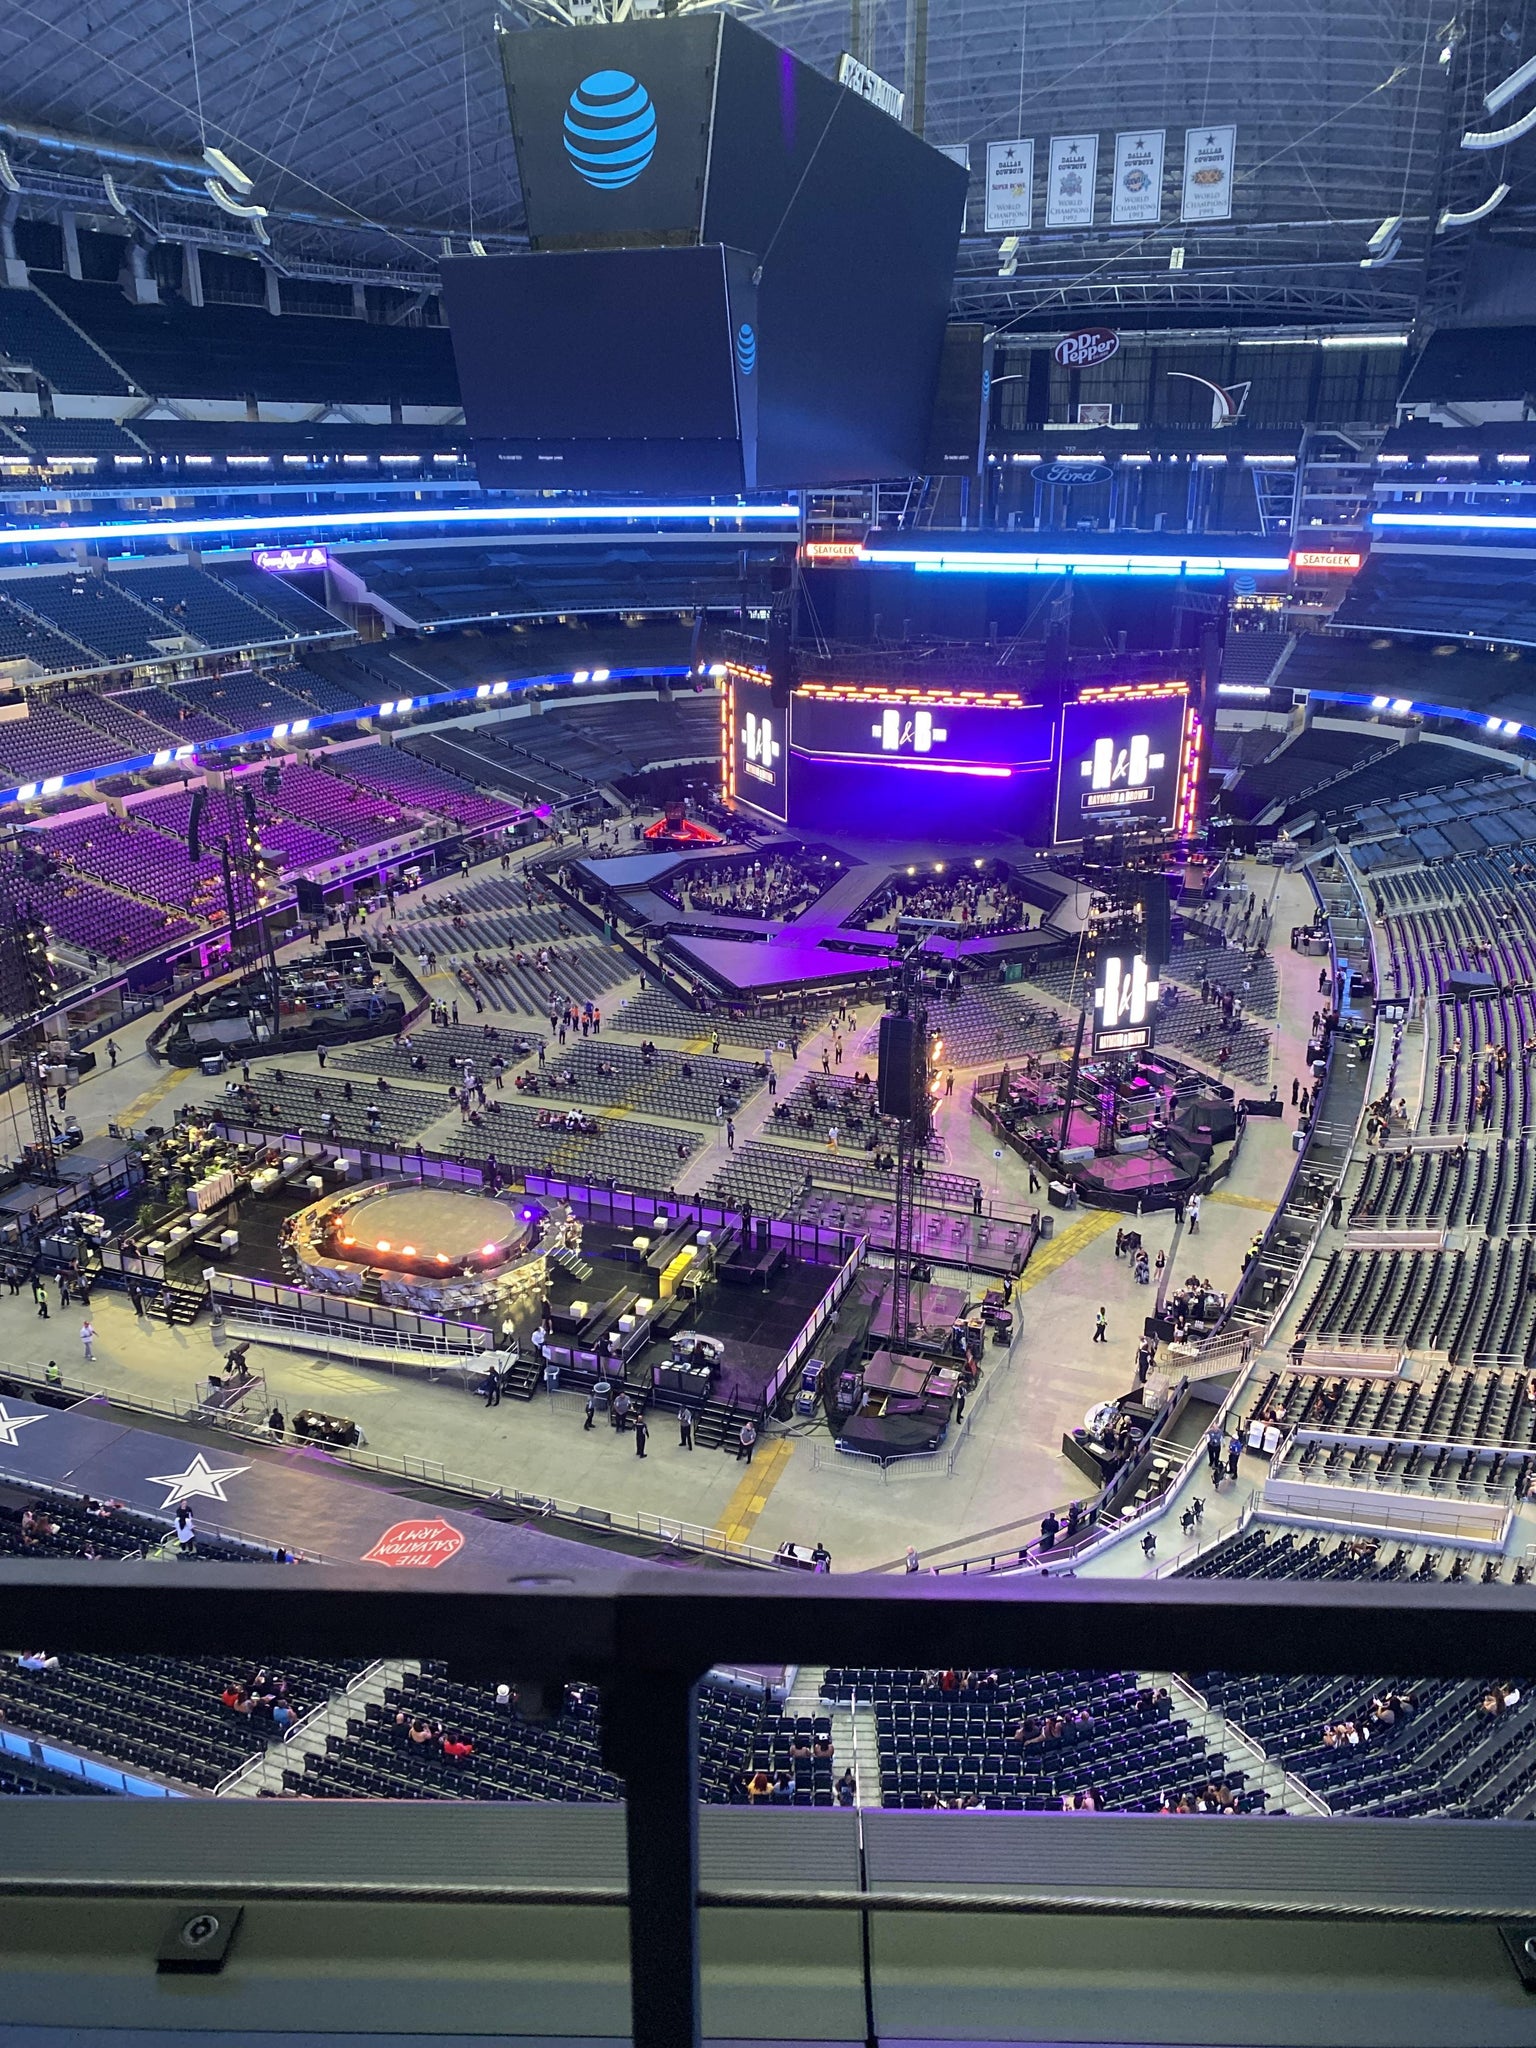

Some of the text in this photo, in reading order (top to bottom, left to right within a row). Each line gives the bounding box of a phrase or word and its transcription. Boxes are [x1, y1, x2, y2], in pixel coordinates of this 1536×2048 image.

[1127, 152, 1151, 160] DALLAS
[1198, 147, 1222, 156] DALLAS
[1061, 156, 1085, 164] DALLAS
[1124, 158, 1154, 167] COWBOYS
[1194, 154, 1225, 163] COWBOYS
[998, 160, 1022, 168] DALLAS
[1058, 163, 1087, 171] COWBOYS
[995, 167, 1024, 176] COWBOYS
[1078, 333, 1100, 350] Dr
[1059, 338, 1115, 365] Pepper
[1047, 464, 1096, 482] Ford
[813, 545, 855, 555] SEATGEEK
[1303, 554, 1352, 566] SEATGEEK
[389, 1527, 447, 1543] ARMY
[372, 1539, 460, 1557] SALVATION
[395, 1554, 432, 1566] THE
